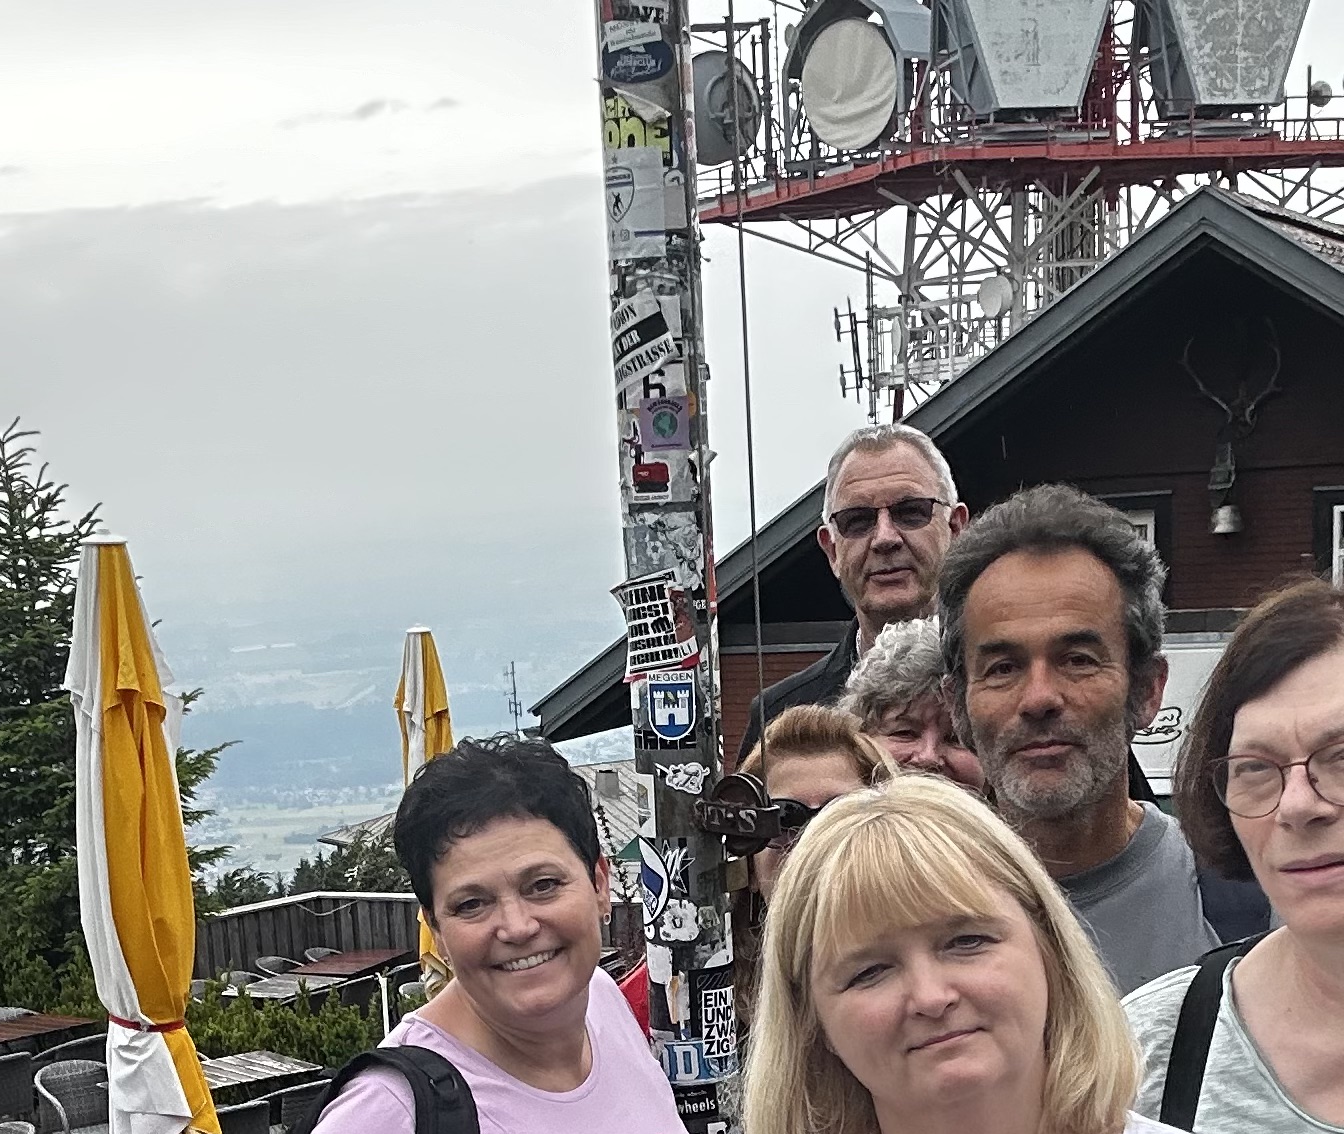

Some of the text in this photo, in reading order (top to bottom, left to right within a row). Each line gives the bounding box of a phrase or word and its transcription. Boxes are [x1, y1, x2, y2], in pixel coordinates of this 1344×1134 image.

[649, 672, 693, 682] MEGGEN
[703, 990, 728, 1009] EIN
[704, 1006, 732, 1025] UND
[704, 1038, 731, 1057] ZIG
